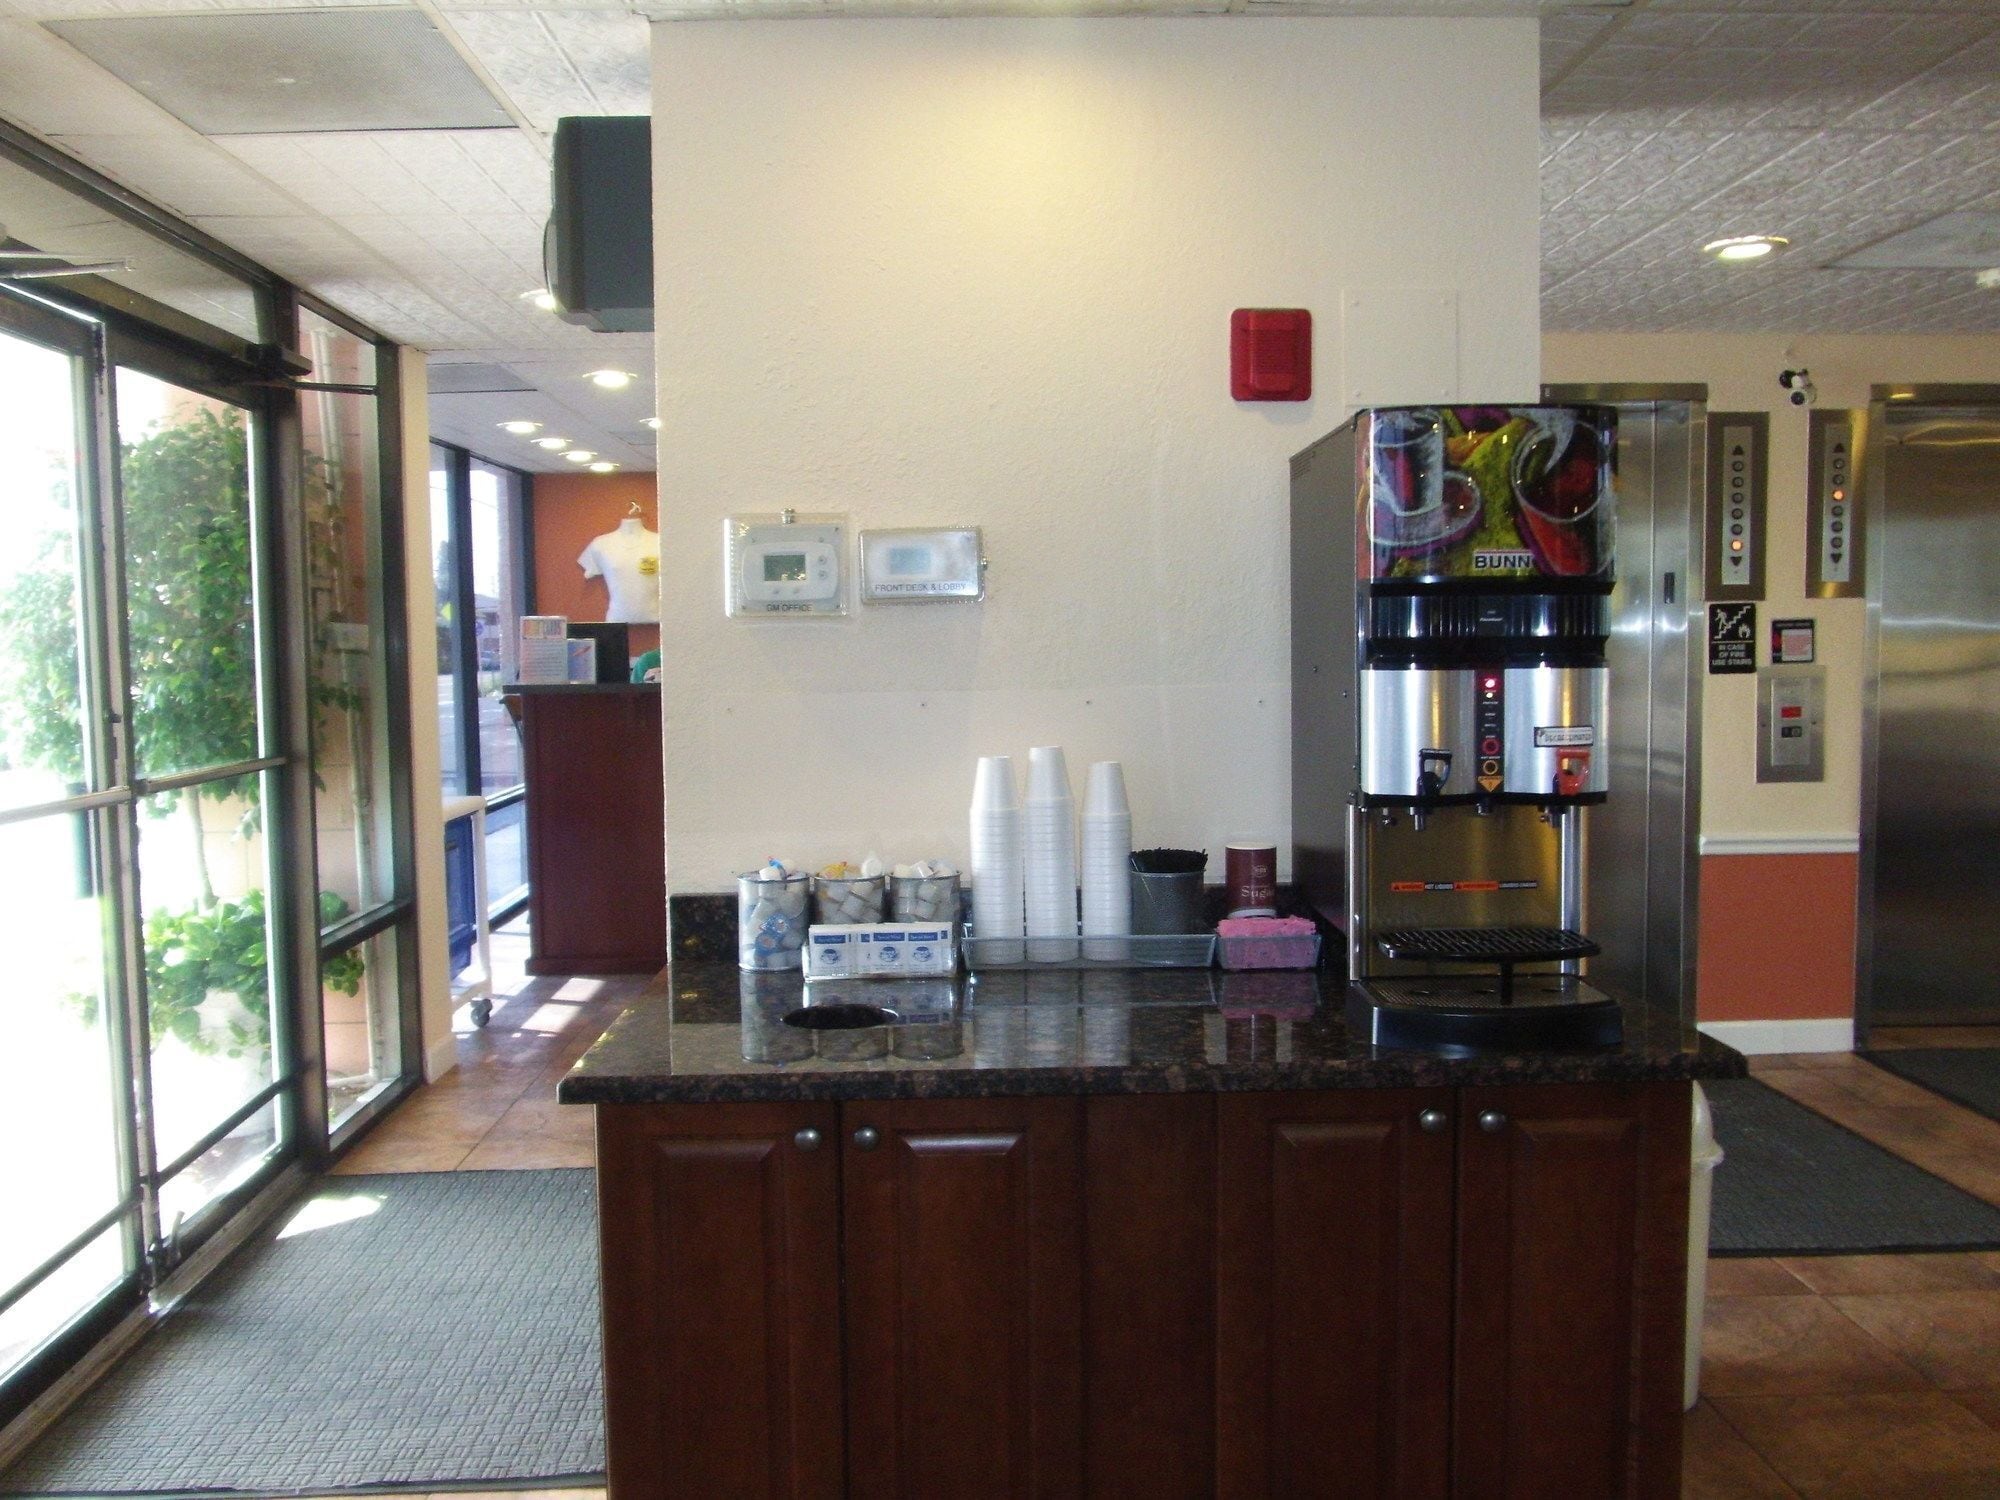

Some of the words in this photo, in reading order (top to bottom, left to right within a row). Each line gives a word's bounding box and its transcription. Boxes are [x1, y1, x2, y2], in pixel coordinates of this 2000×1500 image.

[1474, 555, 1530, 569] BUNN
[875, 584, 903, 593] FRONT
[906, 584, 928, 592] DESK
[930, 584, 937, 592] &
[938, 583, 966, 591] LOBBY
